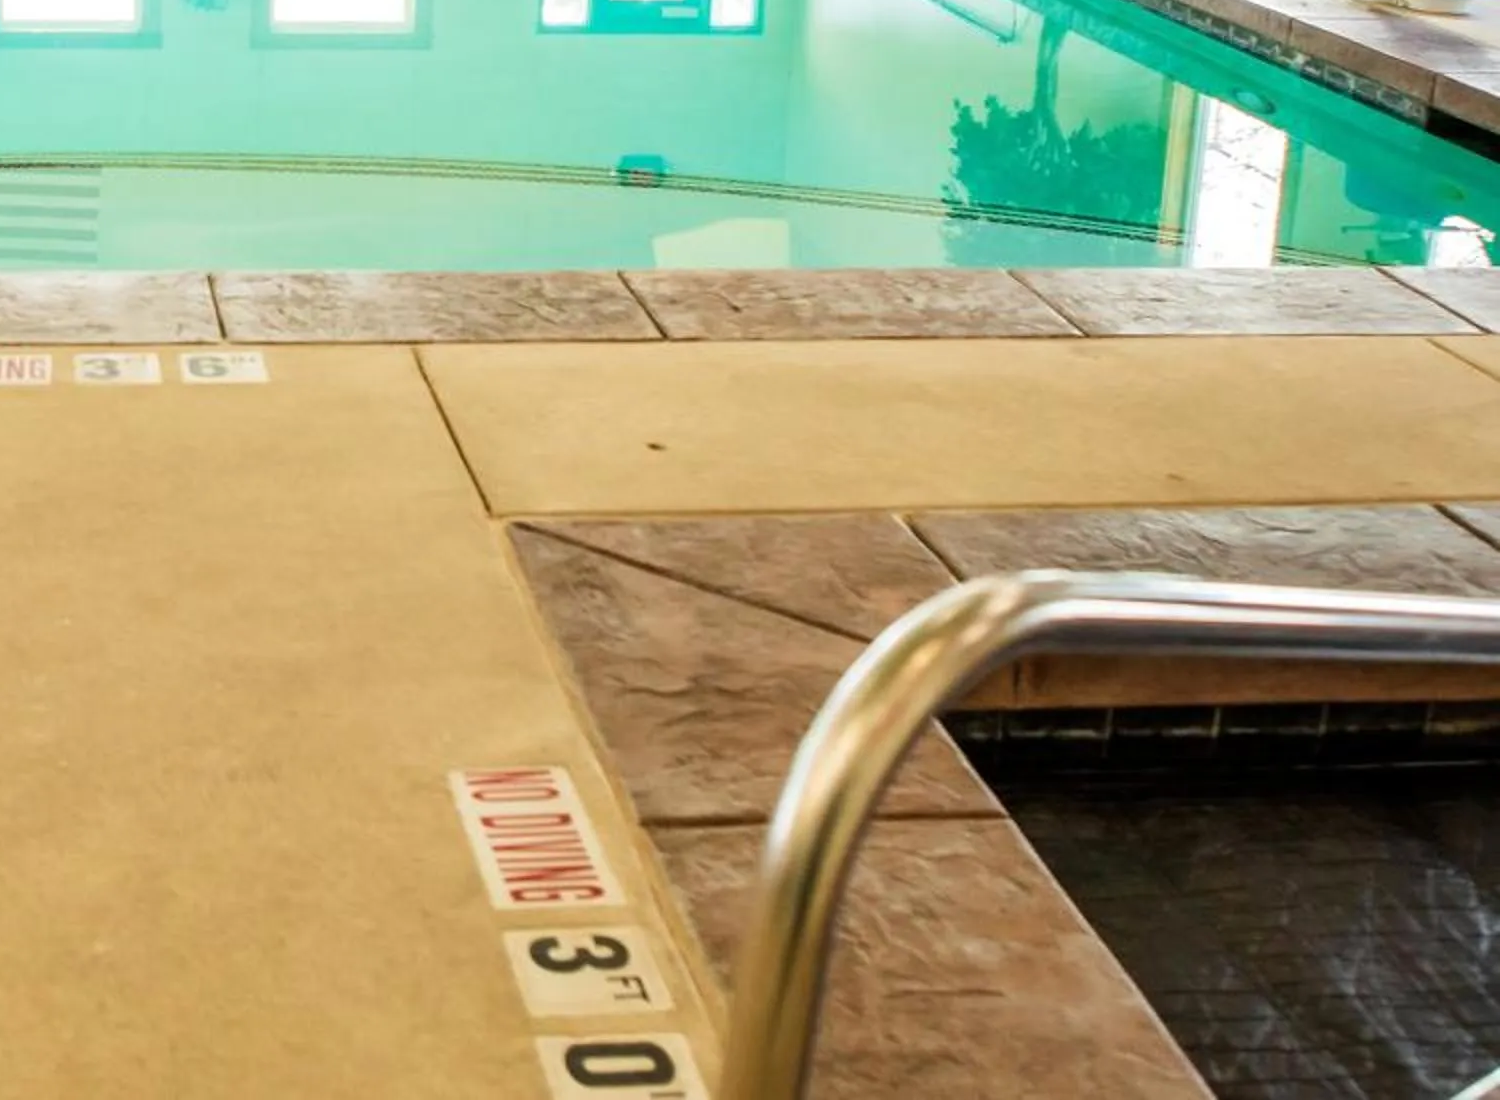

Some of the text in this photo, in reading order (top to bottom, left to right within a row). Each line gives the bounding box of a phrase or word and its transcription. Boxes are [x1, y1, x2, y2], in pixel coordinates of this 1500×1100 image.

[82, 358, 121, 380] 3
[187, 356, 229, 378] 6
[464, 768, 606, 903] NO DIVING
[528, 934, 652, 1005] 3 FT
[563, 1040, 677, 1089] 0
